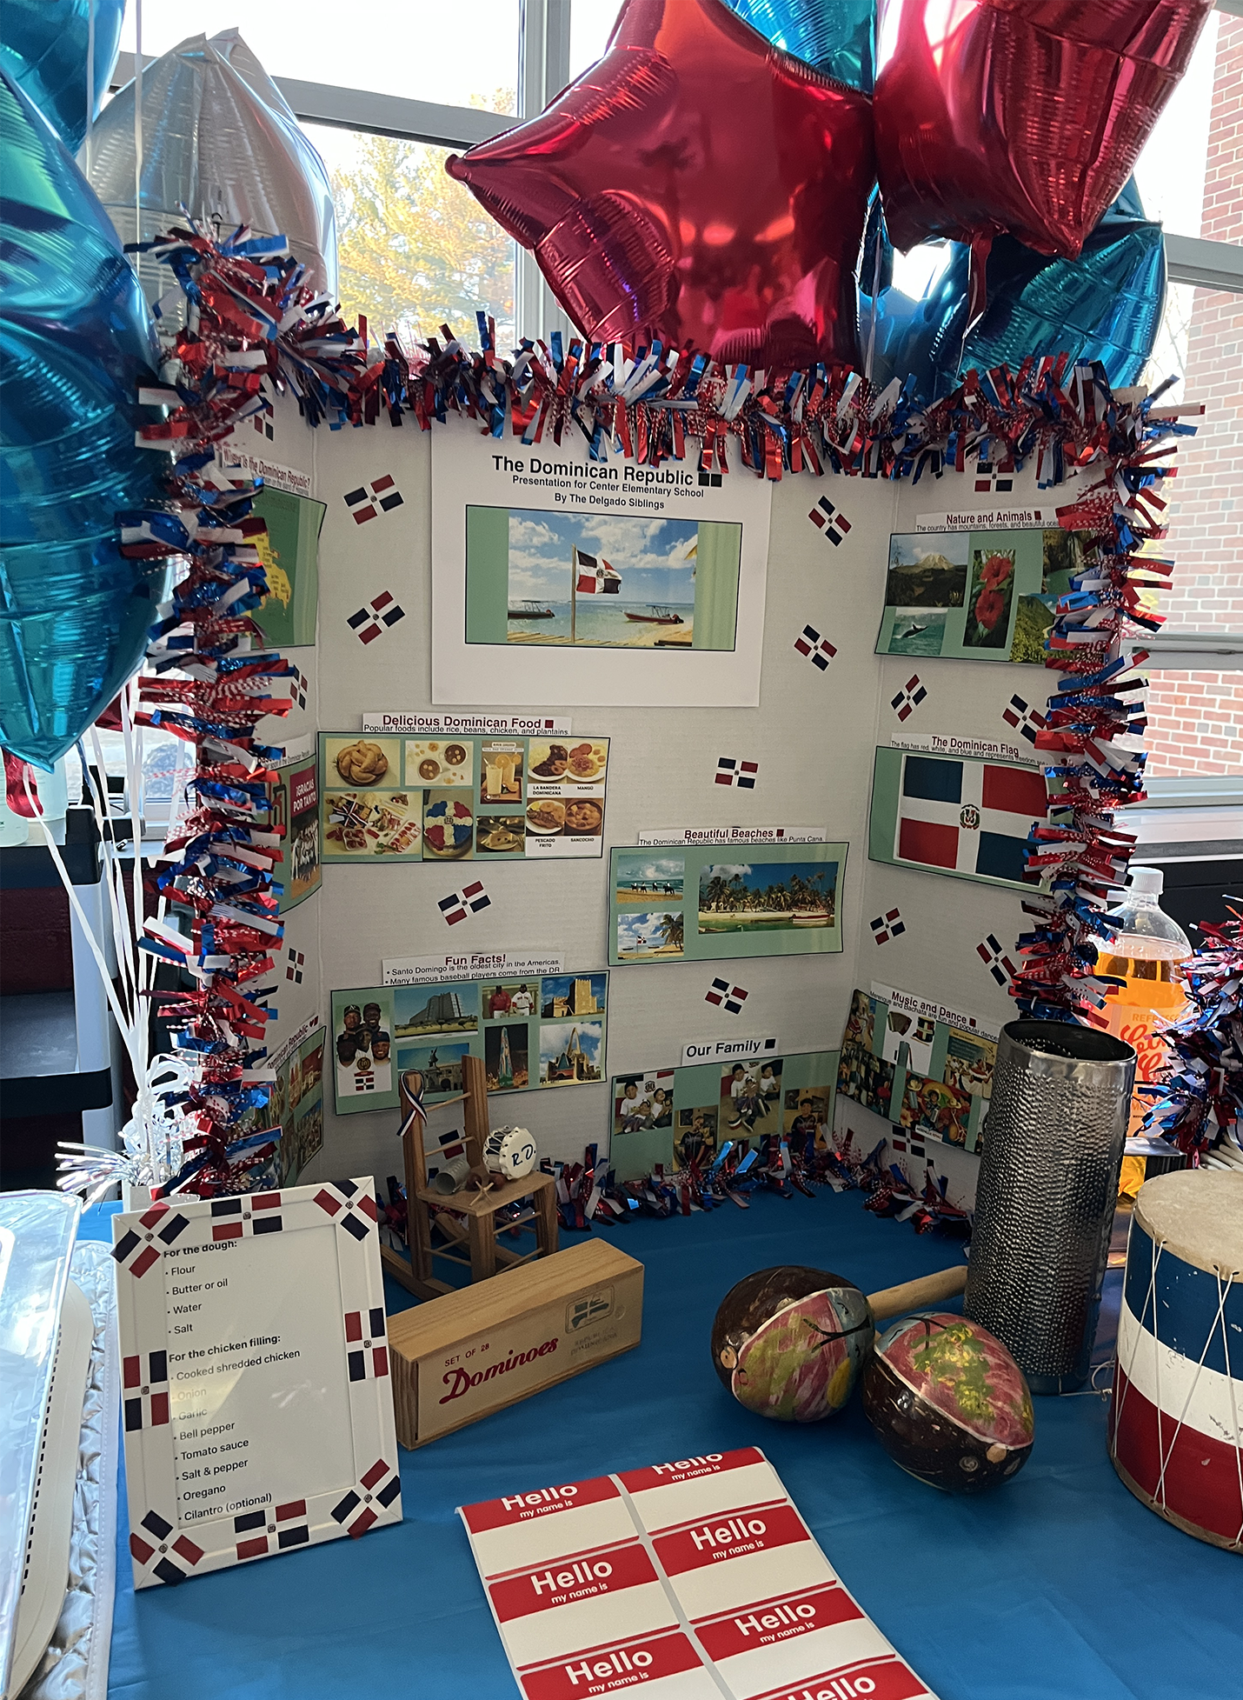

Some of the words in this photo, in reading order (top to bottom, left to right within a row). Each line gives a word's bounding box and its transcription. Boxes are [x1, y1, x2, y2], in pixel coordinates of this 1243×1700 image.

[249, 457, 258, 472] the
[259, 461, 286, 481] Dominican
[288, 470, 310, 489] Republic?
[492, 455, 524, 473] The
[530, 458, 618, 480] Dominican
[624, 466, 693, 485] Republic
[513, 475, 572, 488] Presentation
[574, 480, 587, 489] for
[590, 481, 619, 492] Center
[622, 483, 671, 497] Elementary
[674, 488, 704, 498] School
[555, 493, 567, 504] By
[570, 494, 586, 504] The
[589, 495, 626, 507] Delgado
[629, 498, 664, 510] Siblings
[927, 524, 947, 532] country
[1021, 520, 1045, 528] beautiful
[946, 514, 975, 525] Nature
[977, 513, 993, 523] and
[997, 511, 1032, 522] Animals
[364, 724, 393, 733] Popular
[395, 724, 416, 732] foods
[418, 725, 444, 733] include
[464, 726, 488, 734] beans,
[490, 727, 519, 735] chicken,
[383, 715, 440, 726] Delicious
[444, 716, 507, 727] Dominican
[512, 718, 541, 728] Food
[932, 736, 948, 746] The
[950, 738, 998, 752] Dominican
[1001, 744, 1019, 757] Flag
[985, 752, 1014, 760] represents
[296, 779, 315, 797] ¡GRACIAS
[293, 800, 303, 812] POR
[304, 791, 316, 808] TANTO
[684, 830, 729, 839] Beautiful
[732, 829, 773, 838] Beaches
[392, 968, 413, 976] Santo
[415, 966, 448, 975] Domingo
[456, 963, 468, 971] the
[469, 962, 490, 970] oldest
[491, 961, 505, 970] city
[514, 960, 526, 968] the
[527, 958, 560, 967] Americas.
[445, 956, 467, 966] Fun
[471, 954, 506, 965] Facts!
[390, 976, 410, 985] Many
[412, 975, 439, 983] famous
[440, 973, 470, 981] baseball
[471, 972, 496, 980] players
[870, 991, 892, 1005] Merengue
[904, 1004, 927, 1016] Bachata
[948, 1018, 958, 1027] and
[959, 1023, 980, 1034] popular
[892, 991, 918, 1007] Music
[920, 1002, 937, 1013] and
[939, 1007, 967, 1024] Dance
[267, 1045, 288, 1069] Dominican
[289, 1024, 308, 1046] Republic
[687, 1046, 711, 1057] Our
[716, 1040, 761, 1054] Family
[164, 1250, 180, 1258] For
[183, 1245, 199, 1255] the
[202, 1240, 237, 1252] dough:
[171, 1265, 196, 1276] Flour
[172, 1284, 202, 1295] Butter
[205, 1281, 214, 1289] or
[217, 1278, 228, 1288] oil
[173, 1303, 202, 1314] Water
[174, 1324, 193, 1335] Salt
[169, 1353, 186, 1362] For
[188, 1349, 205, 1359] the
[207, 1340, 248, 1356] chicken
[249, 1334, 281, 1347] filling:
[445, 1355, 461, 1367] SET
[465, 1348, 476, 1359] OF
[481, 1343, 490, 1352] 28
[176, 1366, 214, 1381] Cooked
[216, 1356, 262, 1373] shredded
[264, 1349, 300, 1364] chicken
[438, 1338, 559, 1404] Dominoes
[177, 1388, 207, 1400] Onion
[180, 1429, 198, 1440] Bell
[200, 1422, 235, 1438] pepper
[180, 1446, 218, 1460] Tomato
[220, 1438, 249, 1452] sauce
[182, 1469, 201, 1481] Salt
[204, 1467, 211, 1475] &
[214, 1459, 248, 1475] pepper
[652, 1453, 724, 1475] Hello
[672, 1473, 687, 1481] my
[688, 1466, 711, 1478] name
[713, 1463, 721, 1471] is
[183, 1485, 226, 1501] Oregano
[502, 1484, 578, 1511] Hello
[184, 1505, 223, 1521] Cilantro
[226, 1492, 272, 1513] (optional)
[520, 1510, 535, 1518] my
[537, 1502, 563, 1515] name
[565, 1498, 573, 1507] is
[690, 1516, 767, 1551] Hello
[712, 1551, 728, 1560] my
[730, 1544, 754, 1557] name
[755, 1540, 764, 1548] is
[530, 1559, 613, 1595] Hello
[551, 1595, 567, 1604] my
[569, 1586, 596, 1600] name
[598, 1582, 608, 1591] is
[733, 1601, 817, 1637] Hello
[760, 1634, 776, 1644] my
[777, 1626, 804, 1640] name
[805, 1621, 815, 1629] is
[565, 1648, 654, 1685] Hello
[588, 1683, 605, 1694] my
[607, 1675, 636, 1689] name
[638, 1671, 649, 1680] is
